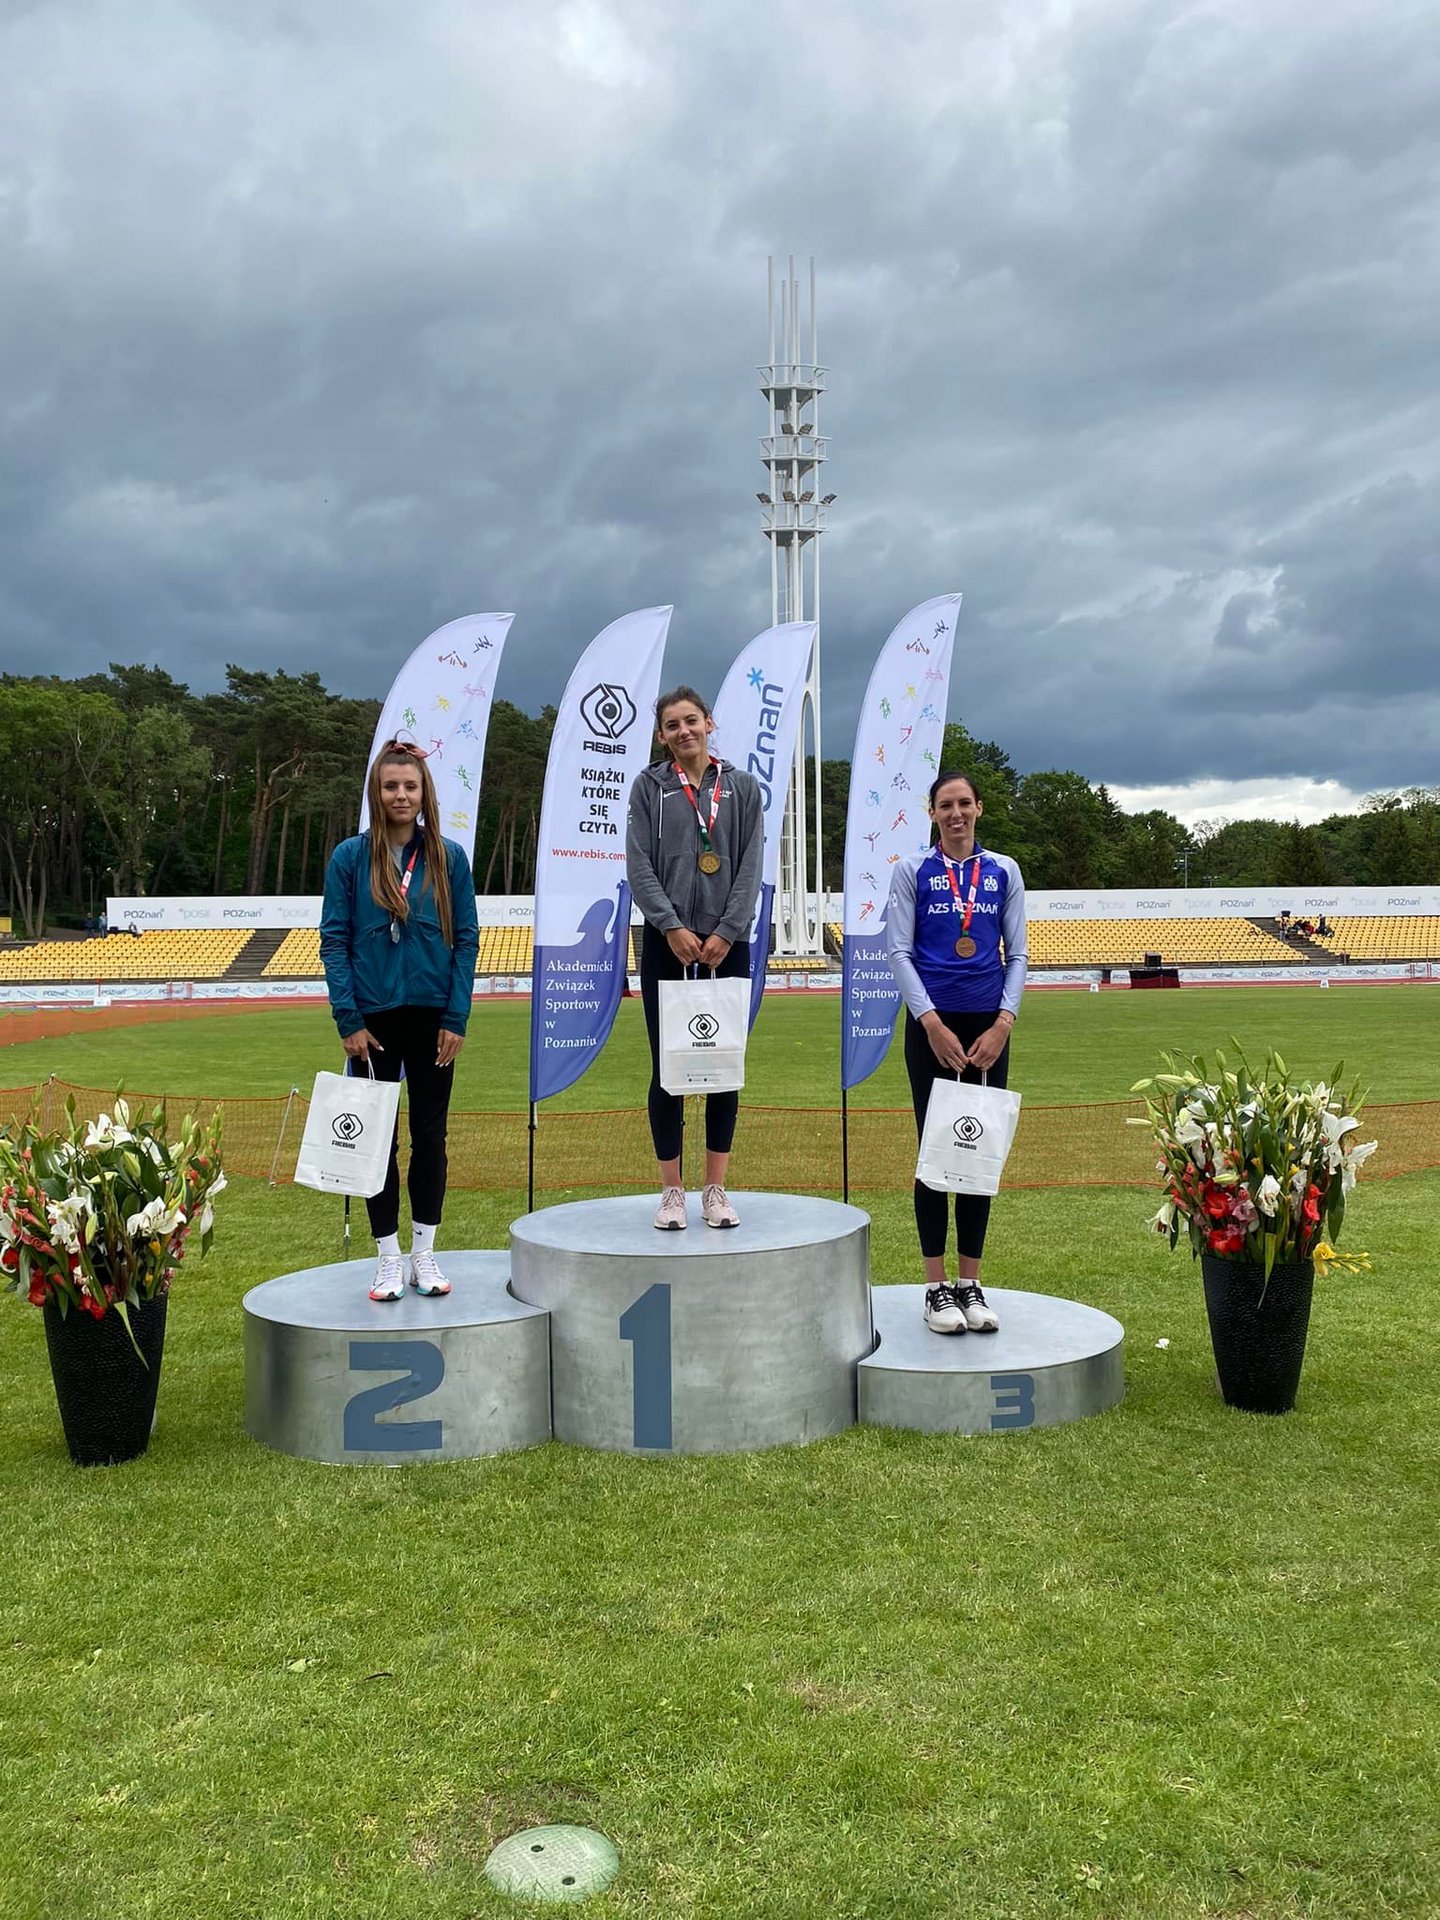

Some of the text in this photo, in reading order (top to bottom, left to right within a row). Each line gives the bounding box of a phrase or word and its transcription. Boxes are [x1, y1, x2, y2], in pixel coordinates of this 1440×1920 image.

[583, 741, 626, 755] REBIS
[581, 768, 625, 785] KSIĄŻKI
[581, 785, 621, 800] KTÓRE
[589, 804, 609, 820] SIĘ
[579, 821, 618, 835] CZYTA
[928, 875, 951, 891] 165
[927, 902, 950, 915] AZS
[546, 960, 613, 972] Akademicki
[546, 979, 596, 994] Związek
[852, 987, 900, 1002] Sportowy
[545, 998, 601, 1013] Sportowy
[852, 1010, 862, 1018] w
[545, 1021, 556, 1029] w
[544, 1035, 597, 1049] Poznaniu
[619, 1283, 673, 1450] 1
[343, 1340, 446, 1451] 2
[990, 1374, 1036, 1429] 3
